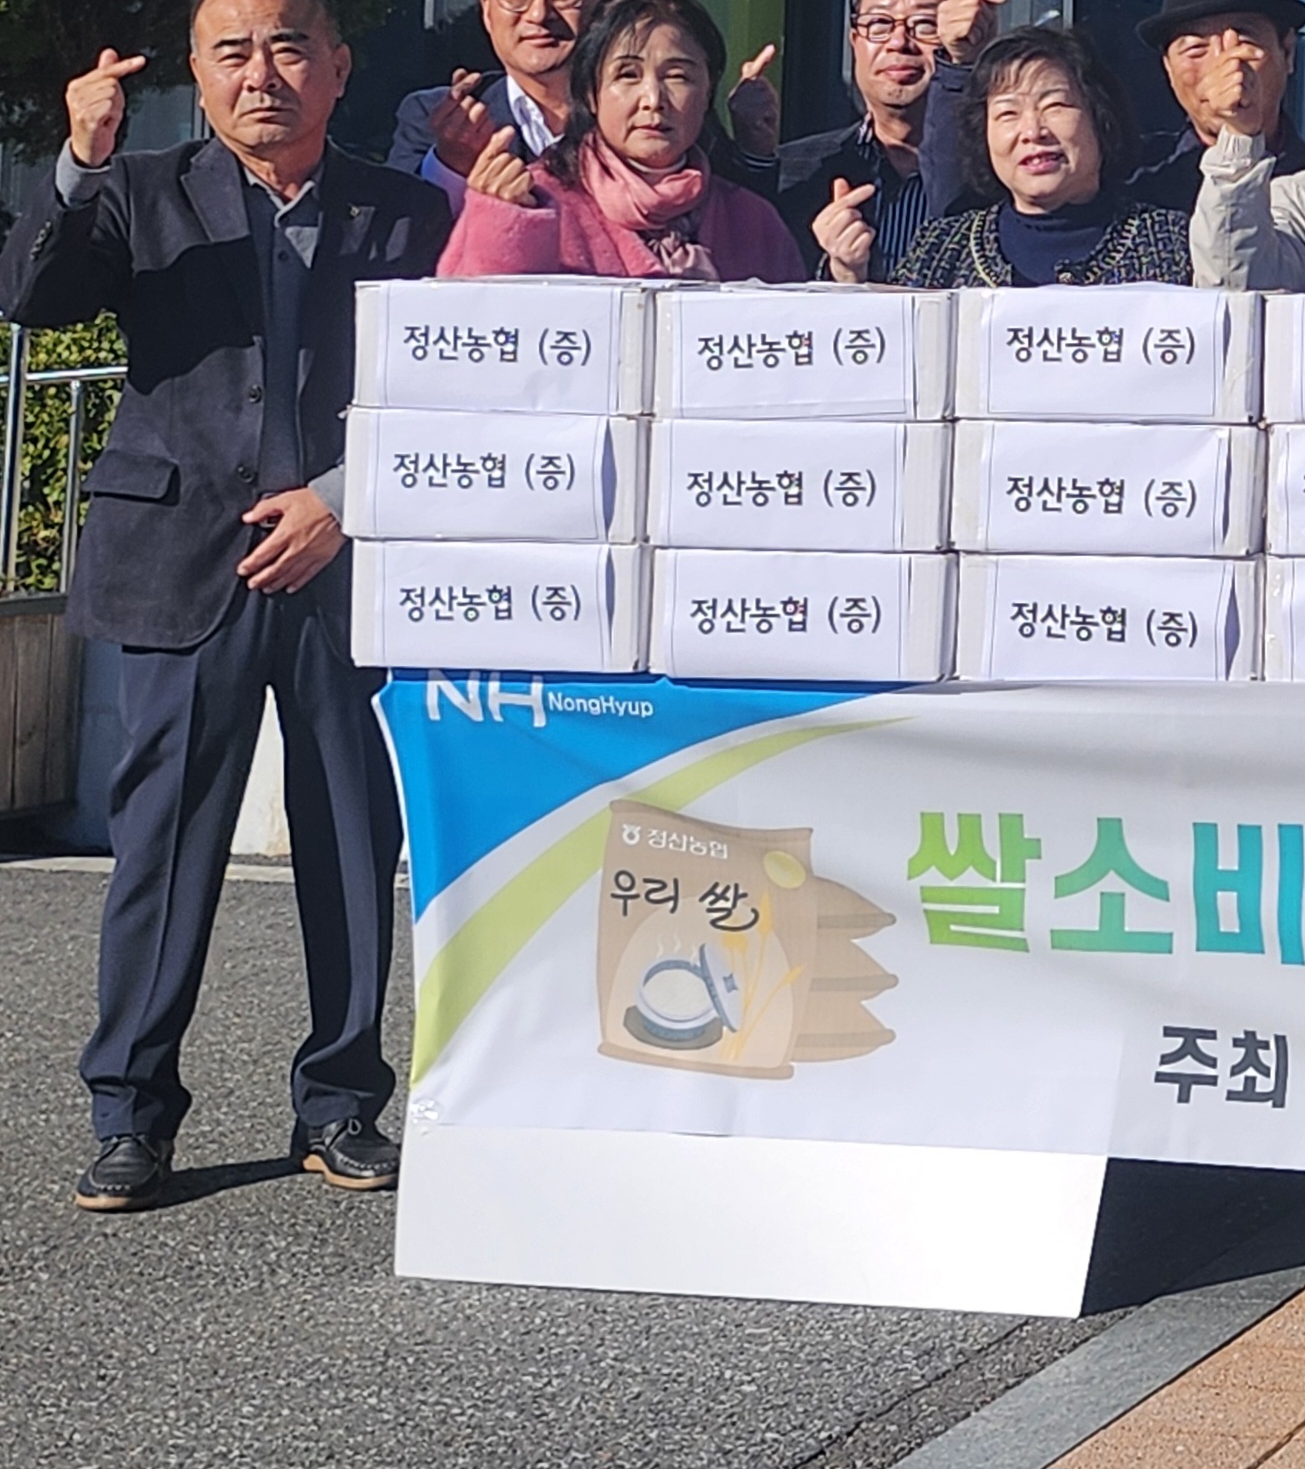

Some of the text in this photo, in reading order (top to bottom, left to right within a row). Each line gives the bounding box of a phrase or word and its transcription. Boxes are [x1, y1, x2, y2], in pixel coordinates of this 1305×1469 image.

[403, 326, 593, 366] 정산농협 (증)
[697, 327, 887, 370] 정산농협 (증)
[1006, 326, 1196, 365] 정산농협 (증)
[392, 453, 576, 490] 정산농협 (증)
[686, 469, 877, 507] 정산농협 (증)
[1006, 476, 1198, 517] 정산농협 (증)
[399, 584, 582, 622] 정산농협 (증)
[690, 596, 882, 634] 정산농협 (증)
[1010, 602, 1198, 648] 정산농협 (증)
[426, 668, 655, 728] NH NongHyup
[610, 870, 760, 932] 우리 쌀
[1154, 1025, 1288, 1109] 주최
